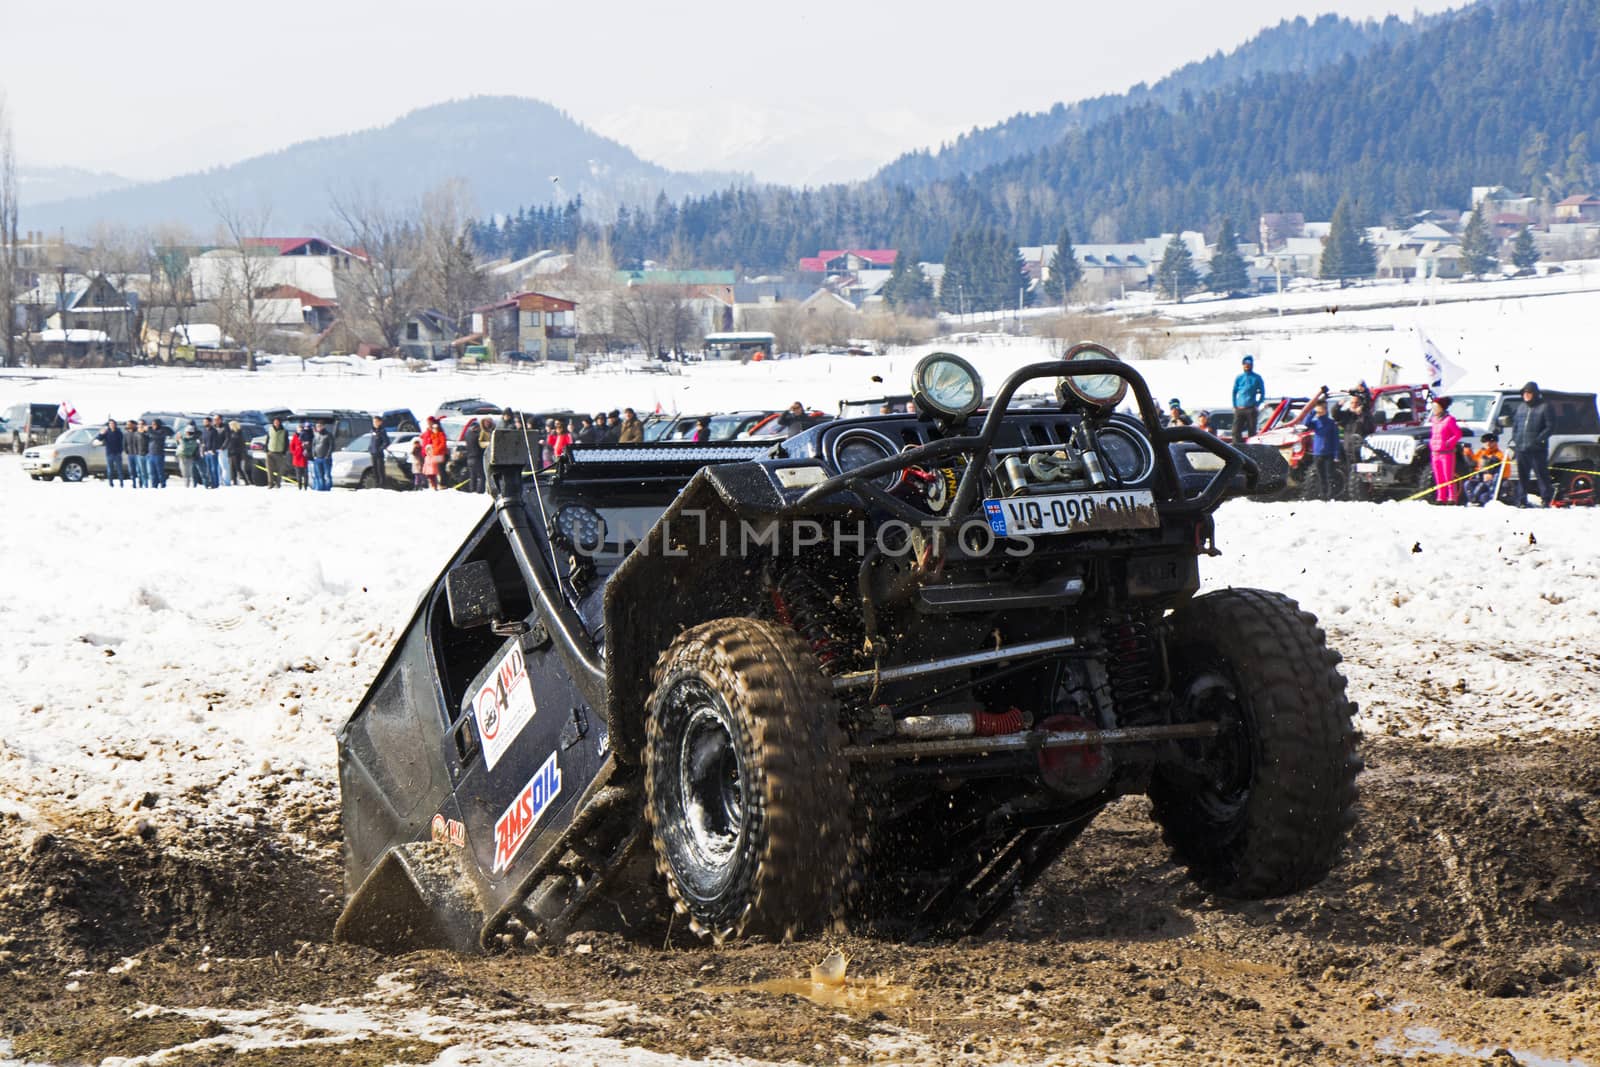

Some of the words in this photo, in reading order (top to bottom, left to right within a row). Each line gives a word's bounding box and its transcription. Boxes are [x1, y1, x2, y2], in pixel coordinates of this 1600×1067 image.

[991, 520, 1005, 533] GE
[495, 650, 522, 711] 4WD
[497, 760, 559, 863] AMSOIL
